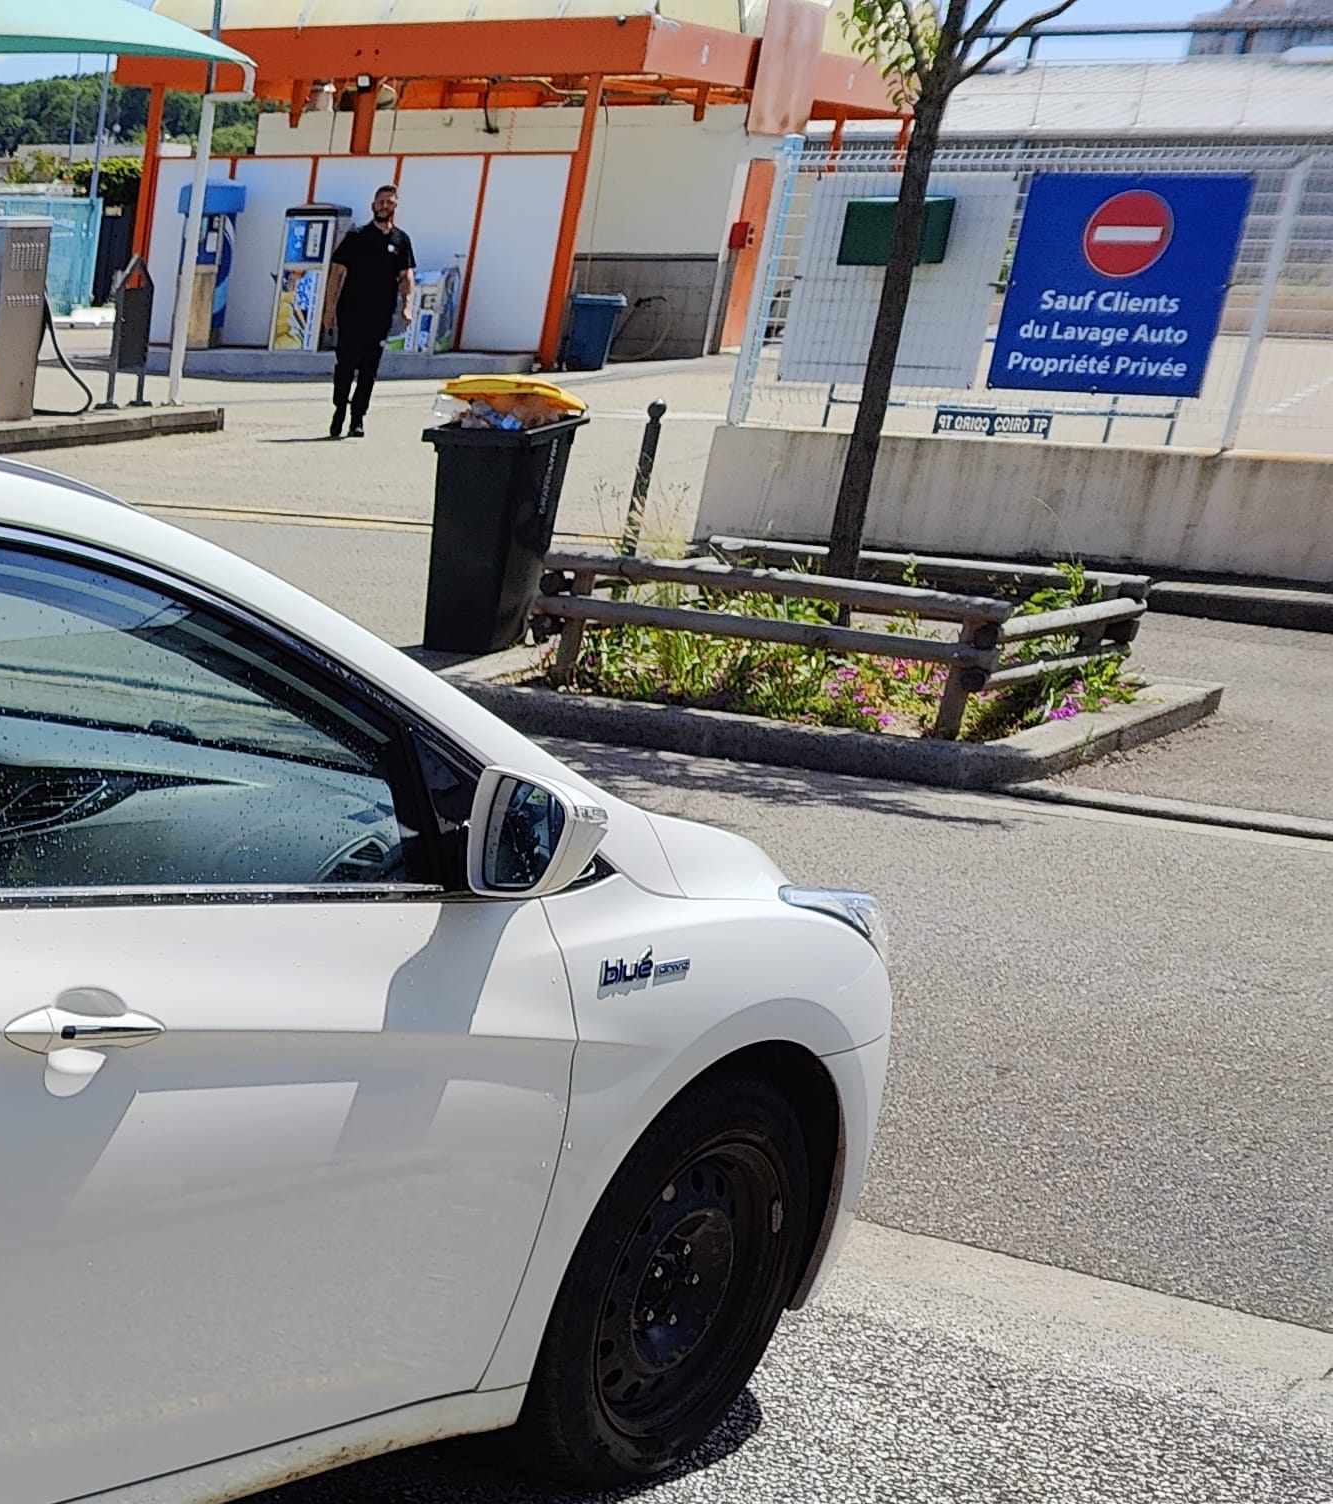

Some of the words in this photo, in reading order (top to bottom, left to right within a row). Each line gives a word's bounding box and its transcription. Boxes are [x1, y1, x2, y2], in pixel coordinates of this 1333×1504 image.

[1040, 289, 1096, 313] Sauf
[1097, 291, 1181, 314] Clients
[1019, 319, 1047, 340] du
[1051, 321, 1129, 347] Lavage
[1132, 323, 1189, 345] Auto
[1007, 350, 1110, 377] Propriété
[1114, 355, 1188, 378] Privée
